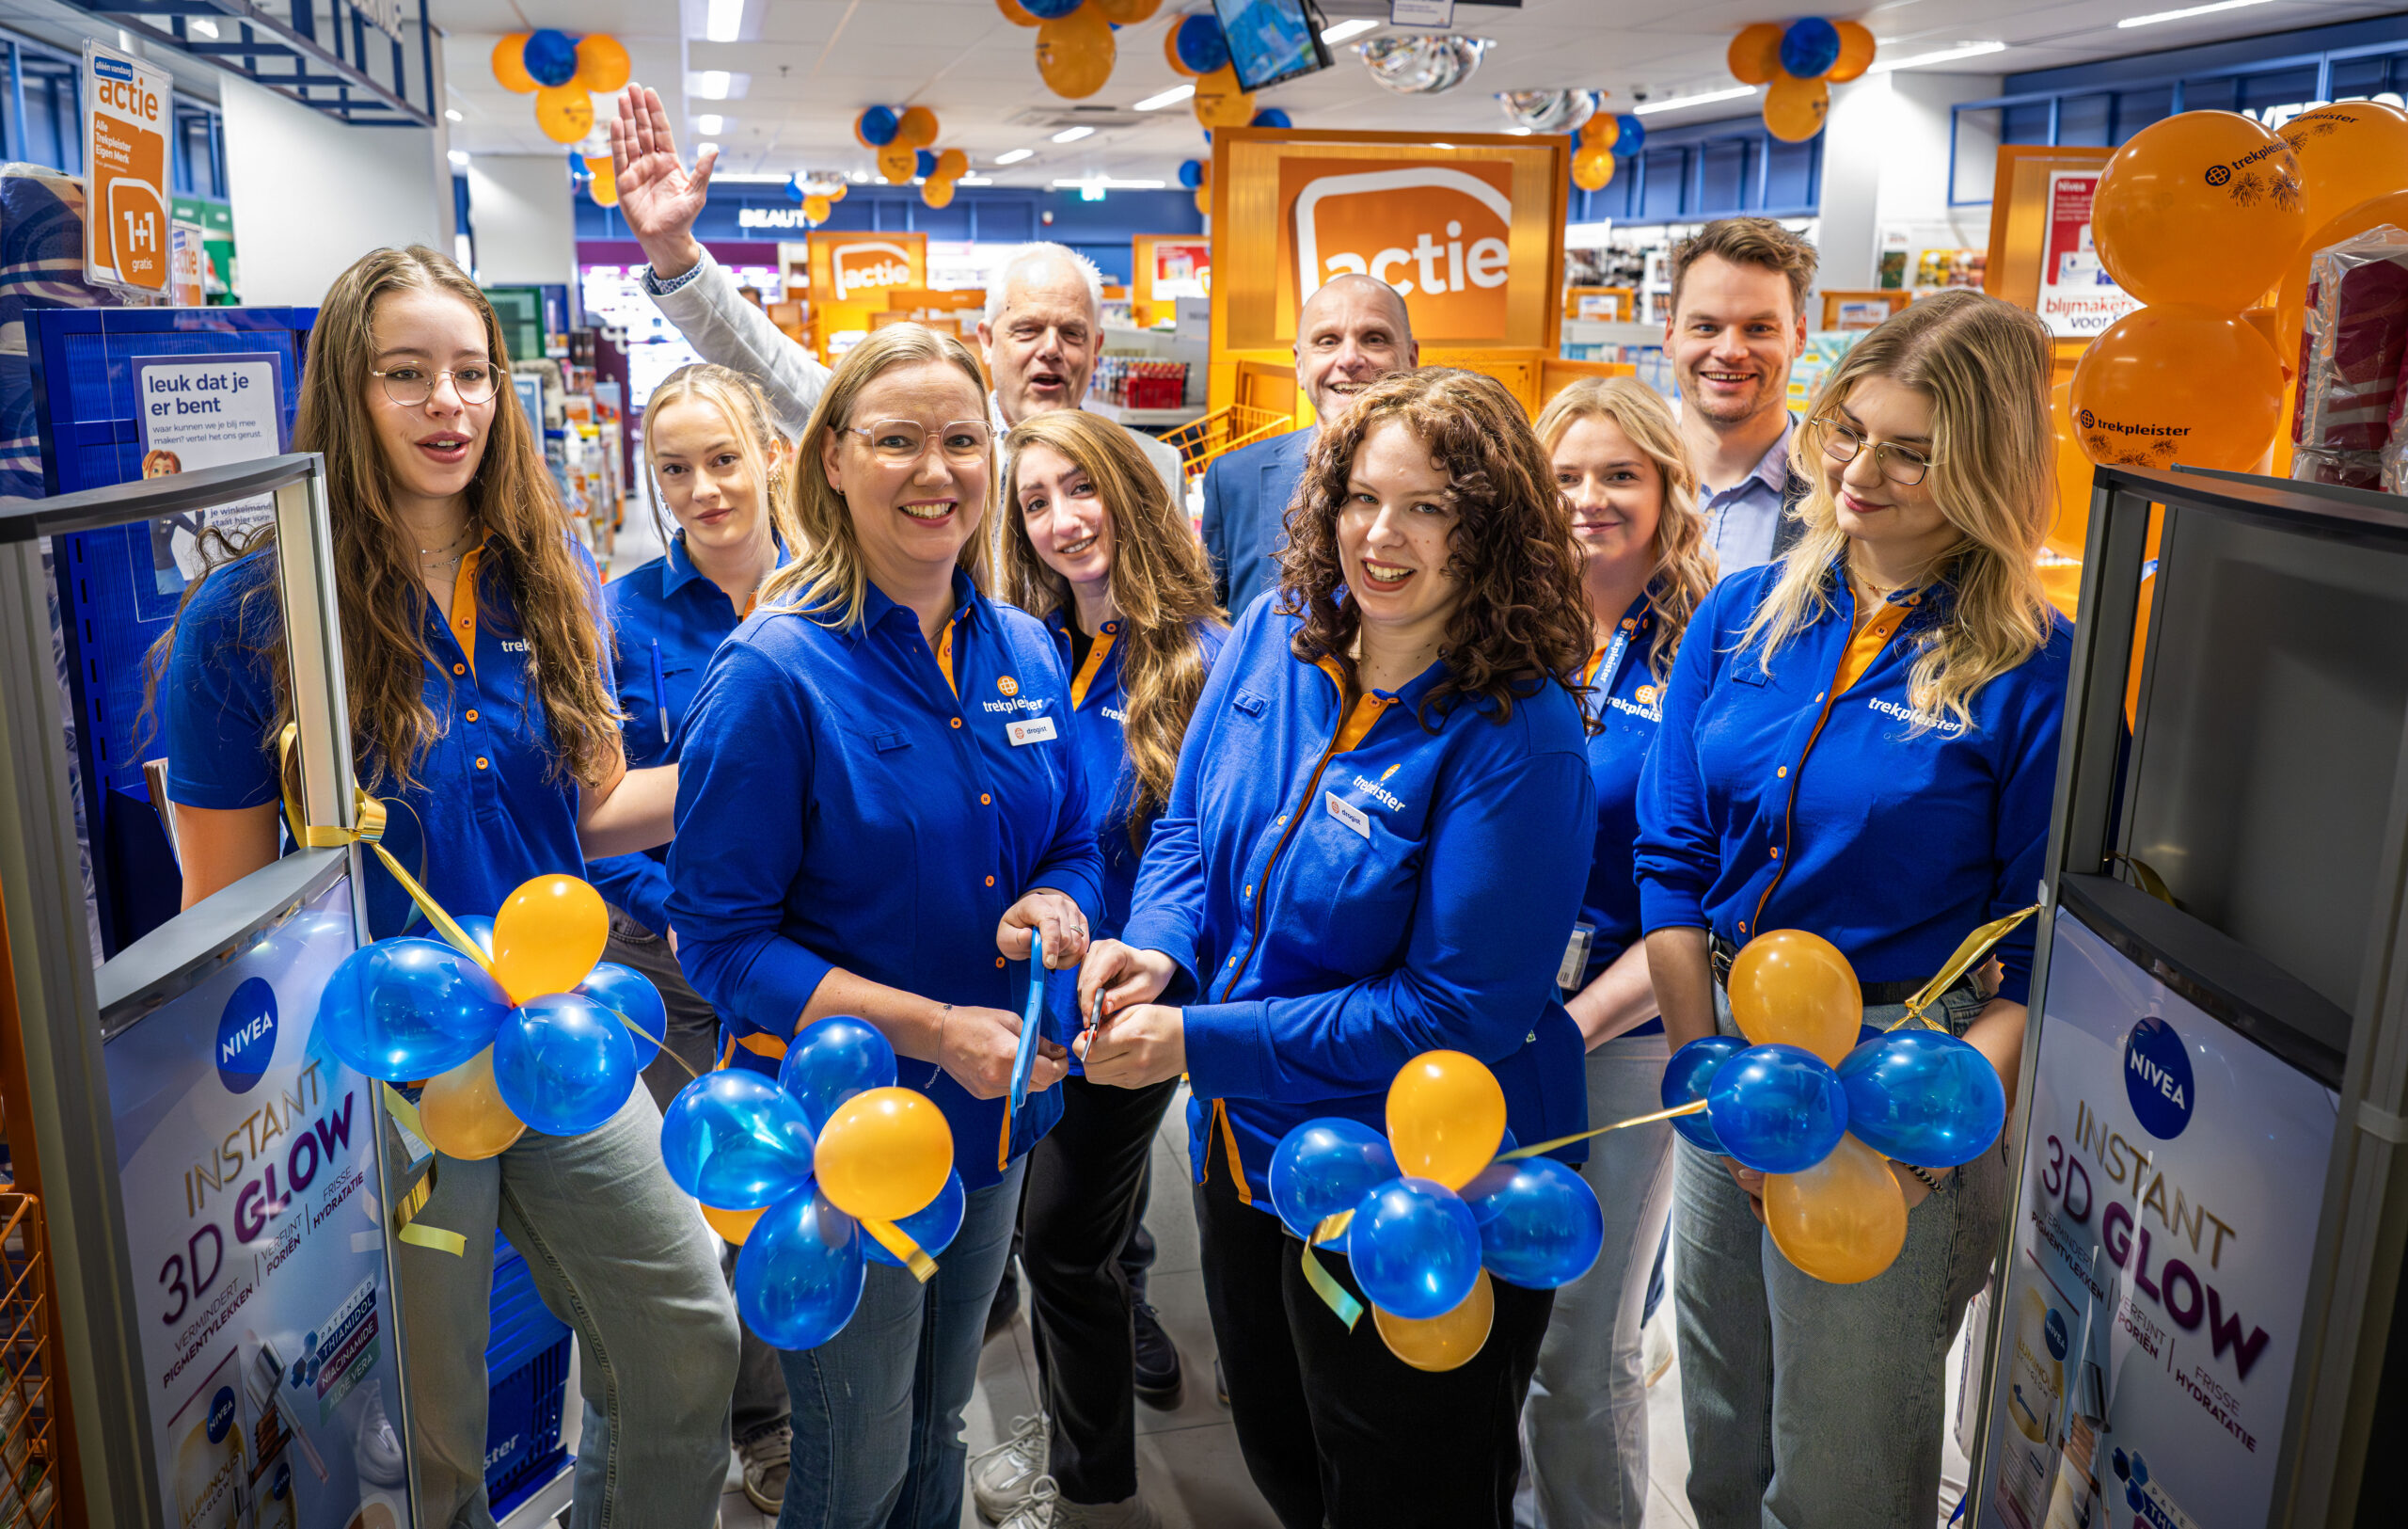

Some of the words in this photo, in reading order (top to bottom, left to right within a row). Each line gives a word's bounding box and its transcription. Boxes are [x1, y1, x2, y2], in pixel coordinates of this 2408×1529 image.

[111, 66, 132, 77] vandaag
[99, 76, 158, 121] actie
[96, 119, 109, 133] Alle
[96, 132, 132, 152] Trekpleister
[95, 145, 113, 158] Eigen
[114, 151, 130, 165] Merk
[123, 211, 156, 252] 1+1
[132, 257, 153, 273] gratis
[844, 259, 911, 289] actie
[1325, 220, 1510, 298] actie
[2070, 316, 2107, 328] voor
[149, 374, 191, 393] leuk
[196, 374, 228, 391] dat
[231, 372, 249, 393] je
[150, 402, 170, 416] er
[176, 397, 221, 415] bent
[152, 425, 172, 434] waar
[174, 423, 203, 432] kunnen
[217, 422, 225, 430] je
[227, 421, 237, 429] blij
[154, 436, 184, 444] maken?
[185, 434, 207, 442] vertel
[2098, 419, 2192, 436] trekpleister
[210, 508, 218, 518] je
[212, 518, 232, 527] staat
[501, 638, 531, 652] trek
[1600, 630, 1628, 683] trekpleister
[1606, 695, 1662, 723] rekpleis
[1341, 809, 1361, 825] drogist
[222, 1011, 273, 1064] NIVEA
[2131, 1047, 2185, 1110] NIVEA
[184, 1059, 321, 1218] INSTANT
[313, 1171, 364, 1229] HYDRATATIE
[324, 1166, 351, 1201] FRISSE
[2075, 1099, 2236, 1270] INSTANT
[159, 1223, 223, 1327] 3D
[234, 1091, 355, 1244] GLOW
[261, 1213, 302, 1261] VERFIJNT
[267, 1234, 301, 1276] PORIËN
[2032, 1212, 2104, 1303] PIGMENTVLEKKEN
[2042, 1135, 2093, 1223] 3D
[2102, 1202, 2271, 1381] GLOW
[174, 1278, 239, 1352] VERMINDERT
[321, 1281, 372, 1340] PATENTED
[323, 1297, 372, 1356] THIAMIDOL
[2119, 1295, 2166, 1346] VERFIJNT
[163, 1283, 253, 1389] PIGMENTVLEKKEN
[322, 1321, 374, 1388] NIACINAMIDE
[2047, 1320, 2066, 1350] NIVEA
[2117, 1312, 2159, 1361] PORIËN
[351, 1354, 373, 1382] VERA
[2176, 1369, 2257, 1454] HYDRATATIE
[2194, 1365, 2241, 1417] FRISSE
[209, 1400, 233, 1432] NIVEA
